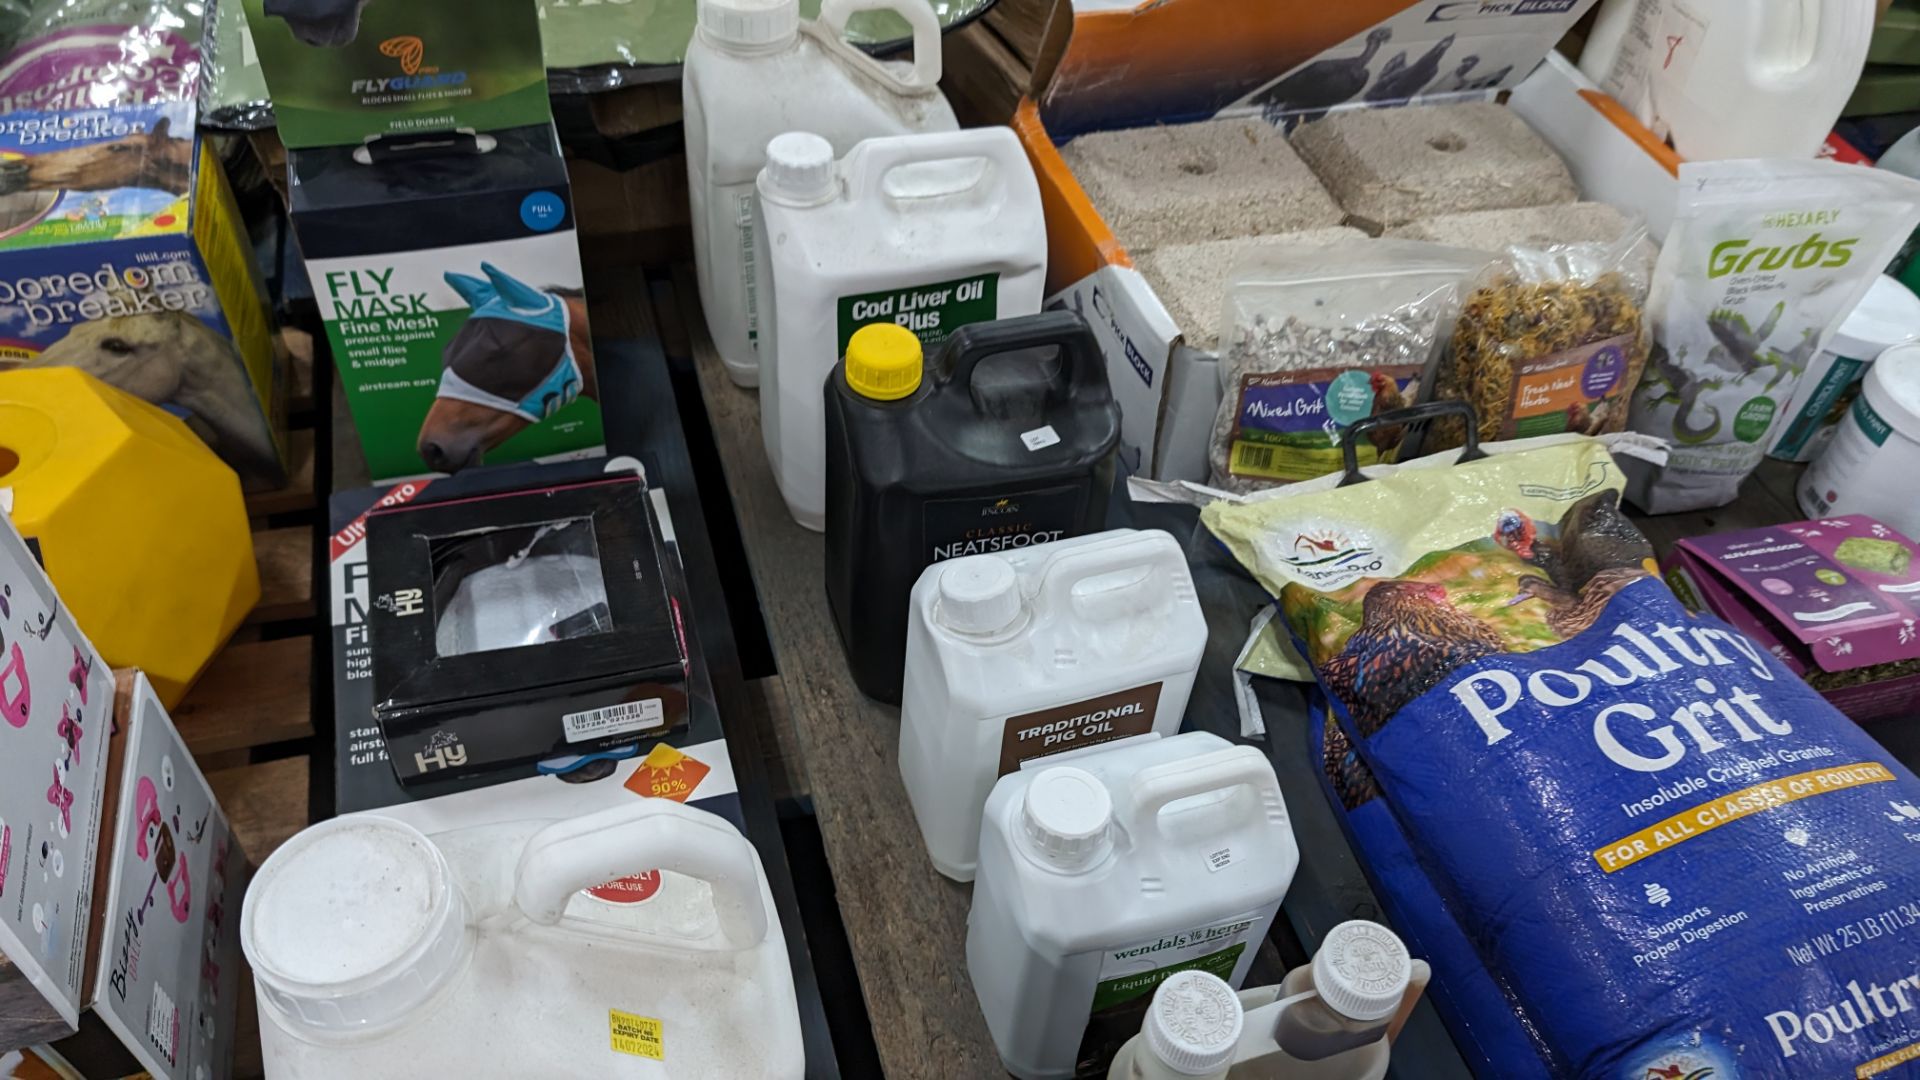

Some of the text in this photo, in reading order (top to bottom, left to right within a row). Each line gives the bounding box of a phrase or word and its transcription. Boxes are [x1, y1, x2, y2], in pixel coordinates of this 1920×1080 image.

[1478, 2, 1514, 14] PICK
[361, 94, 392, 105] BLOCKS
[392, 92, 417, 103] SMALL
[18, 118, 147, 147] breaker
[389, 115, 455, 130] FIELD DURABLE
[531, 204, 552, 214] FULL
[1776, 209, 1841, 229] HEXAFLY
[135, 248, 191, 264] likit.com
[1707, 232, 1860, 280] Grubs
[325, 267, 395, 299] FLY
[18, 281, 208, 328] breaker
[331, 292, 434, 321] MASK
[852, 279, 985, 321] Cod Liver Oil
[338, 315, 440, 337] Fine Mesh
[895, 311, 941, 331] Plus
[344, 330, 437, 348] protects against
[348, 344, 407, 359] small flies
[351, 355, 407, 369] & midges
[358, 377, 437, 393] airstream ears
[1247, 399, 1292, 419] Mixed
[1295, 397, 1324, 417] Grit
[335, 521, 367, 547] Ult
[965, 523, 1033, 539] CLASSIC
[933, 530, 1064, 561] NEATSFOOT
[395, 588, 424, 619] Hy
[346, 625, 368, 646] Fi
[346, 647, 372, 659] sun
[1449, 622, 1775, 747] Poultry
[349, 726, 380, 738] stan
[1017, 702, 1145, 742] TRADITIONAL
[1594, 678, 1793, 773] Grit
[1043, 721, 1114, 748] PIG OIL
[350, 752, 374, 765] full
[414, 743, 468, 773] Hy
[652, 777, 687, 796] 90%
[1621, 744, 1834, 818] Insoluble Crushed Granite
[1600, 764, 1886, 868] FOR ALL CLASSES OF POULTRY
[1783, 850, 1858, 883] No Artificial
[626, 882, 644, 892] USE
[1789, 864, 1877, 901] Ingredients or
[1803, 879, 1888, 915] Preservatives
[1647, 904, 1712, 939] Supports
[1114, 935, 1187, 961] wendals
[1632, 909, 1749, 968] Proper Digestion
[1786, 943, 1815, 968] Net
[1812, 934, 1836, 960] Wt
[1836, 924, 1862, 949] 25
[1862, 916, 1883, 940] LB
[1113, 974, 1157, 993] Liquid
[612, 1028, 660, 1044] EXPIRY DATE
[617, 1023, 643, 1034] BATCH
